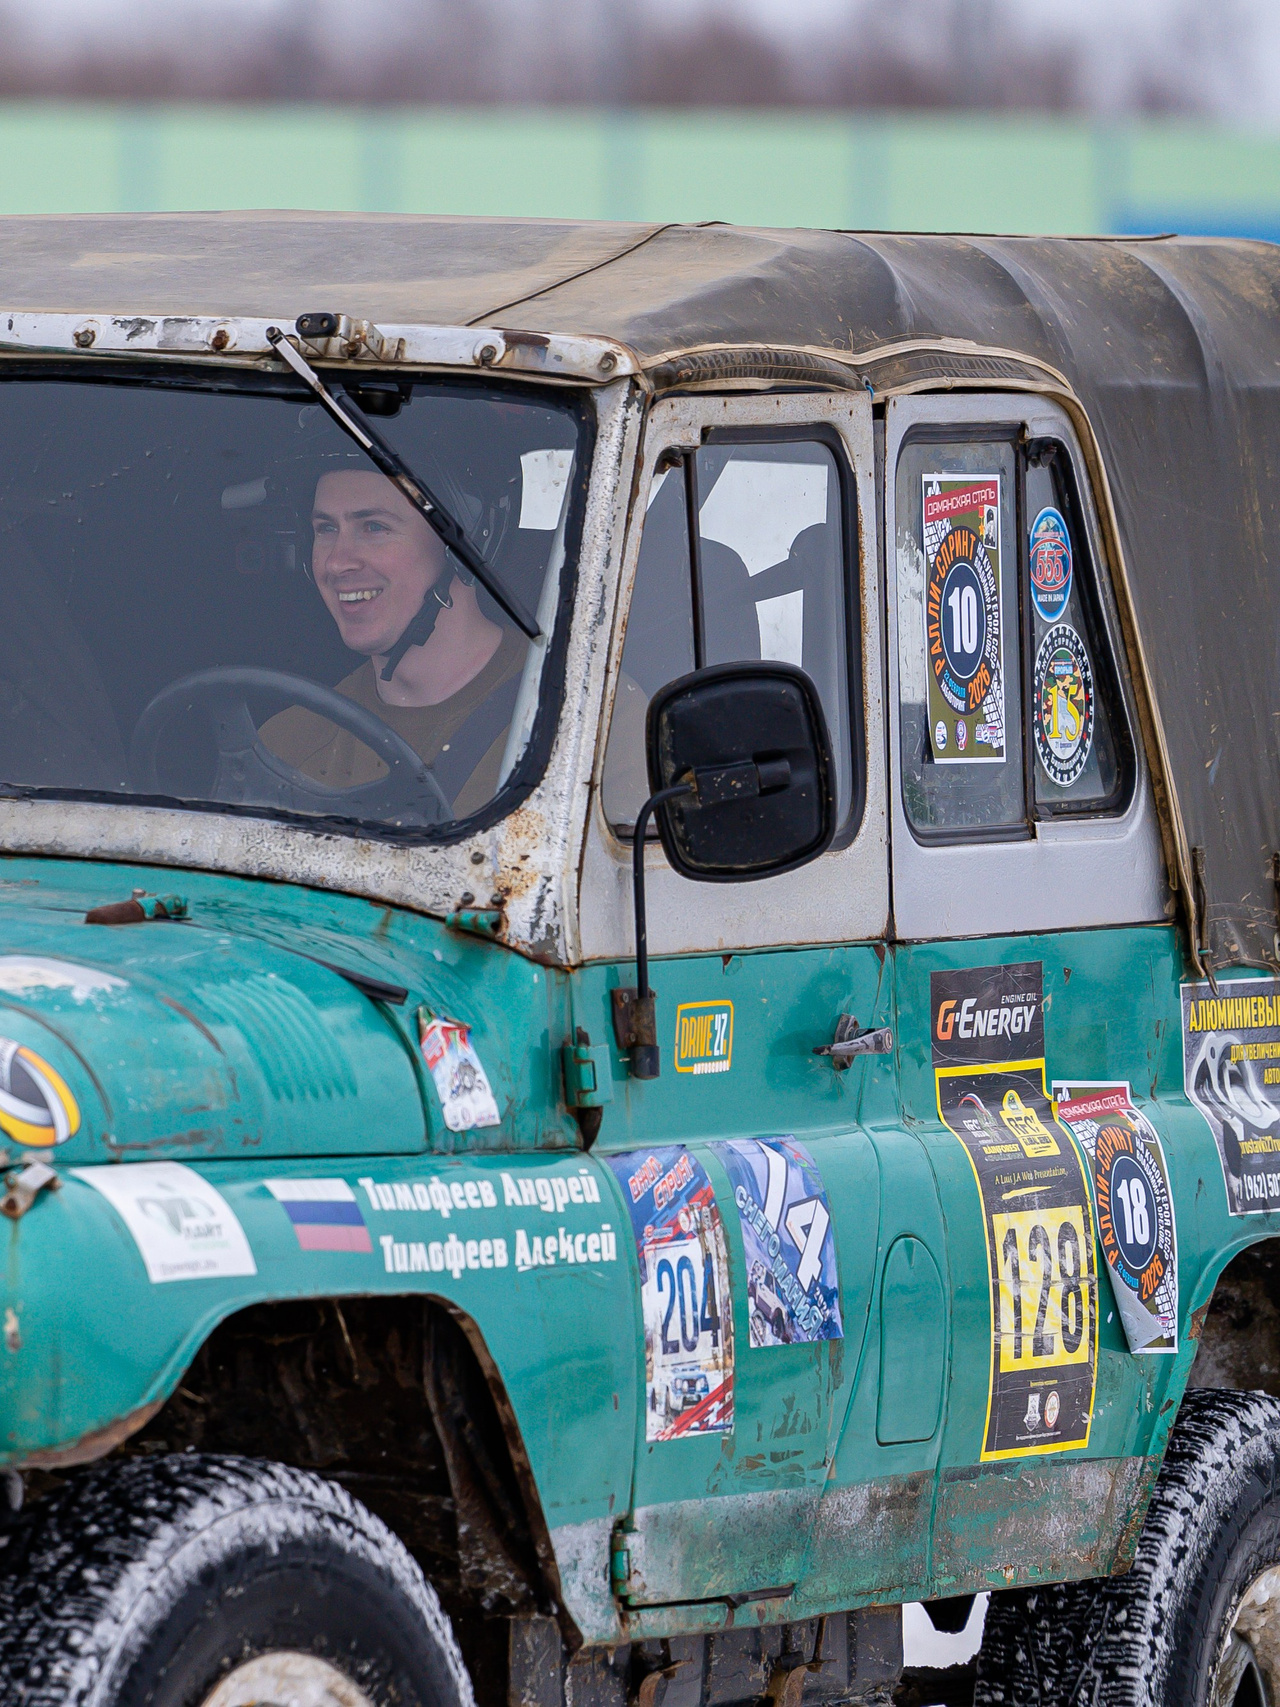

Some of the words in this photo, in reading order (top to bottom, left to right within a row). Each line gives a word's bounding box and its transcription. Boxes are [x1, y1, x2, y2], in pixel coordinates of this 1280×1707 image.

[927, 493, 971, 516] ДАМАНСКАЯ
[972, 488, 996, 504] СТАЛЬ
[983, 554, 997, 595] КУБОК
[1035, 549, 1064, 582] 555
[948, 585, 978, 654] 10
[991, 595, 1000, 635] ГЕРОЯ
[989, 637, 999, 669] СССР
[968, 662, 991, 710] 2026
[1049, 684, 1081, 741] 15
[1000, 993, 1026, 1005] ENGINE
[1026, 992, 1038, 1002] OIL
[1230, 1044, 1244, 1066] ДЛЯ
[1102, 1094, 1126, 1109] СТАЛЬ
[653, 1153, 695, 1212] СПРИНТ
[1144, 1148, 1164, 1187] КУБОК
[358, 1175, 498, 1219] Тимофеев
[500, 1168, 602, 1213] Андрей
[1116, 1177, 1150, 1245] 18
[1160, 1187, 1172, 1227] ГЕРОЯ
[379, 1232, 509, 1279] Тимофеев
[514, 1223, 617, 1269] Алексей
[734, 1184, 824, 1342] СНЕГОМАНИЯ
[1164, 1229, 1172, 1260] СССР
[1002, 1221, 1084, 1360] 128
[1141, 1254, 1164, 1300] 2026
[656, 1252, 721, 1356] 204
